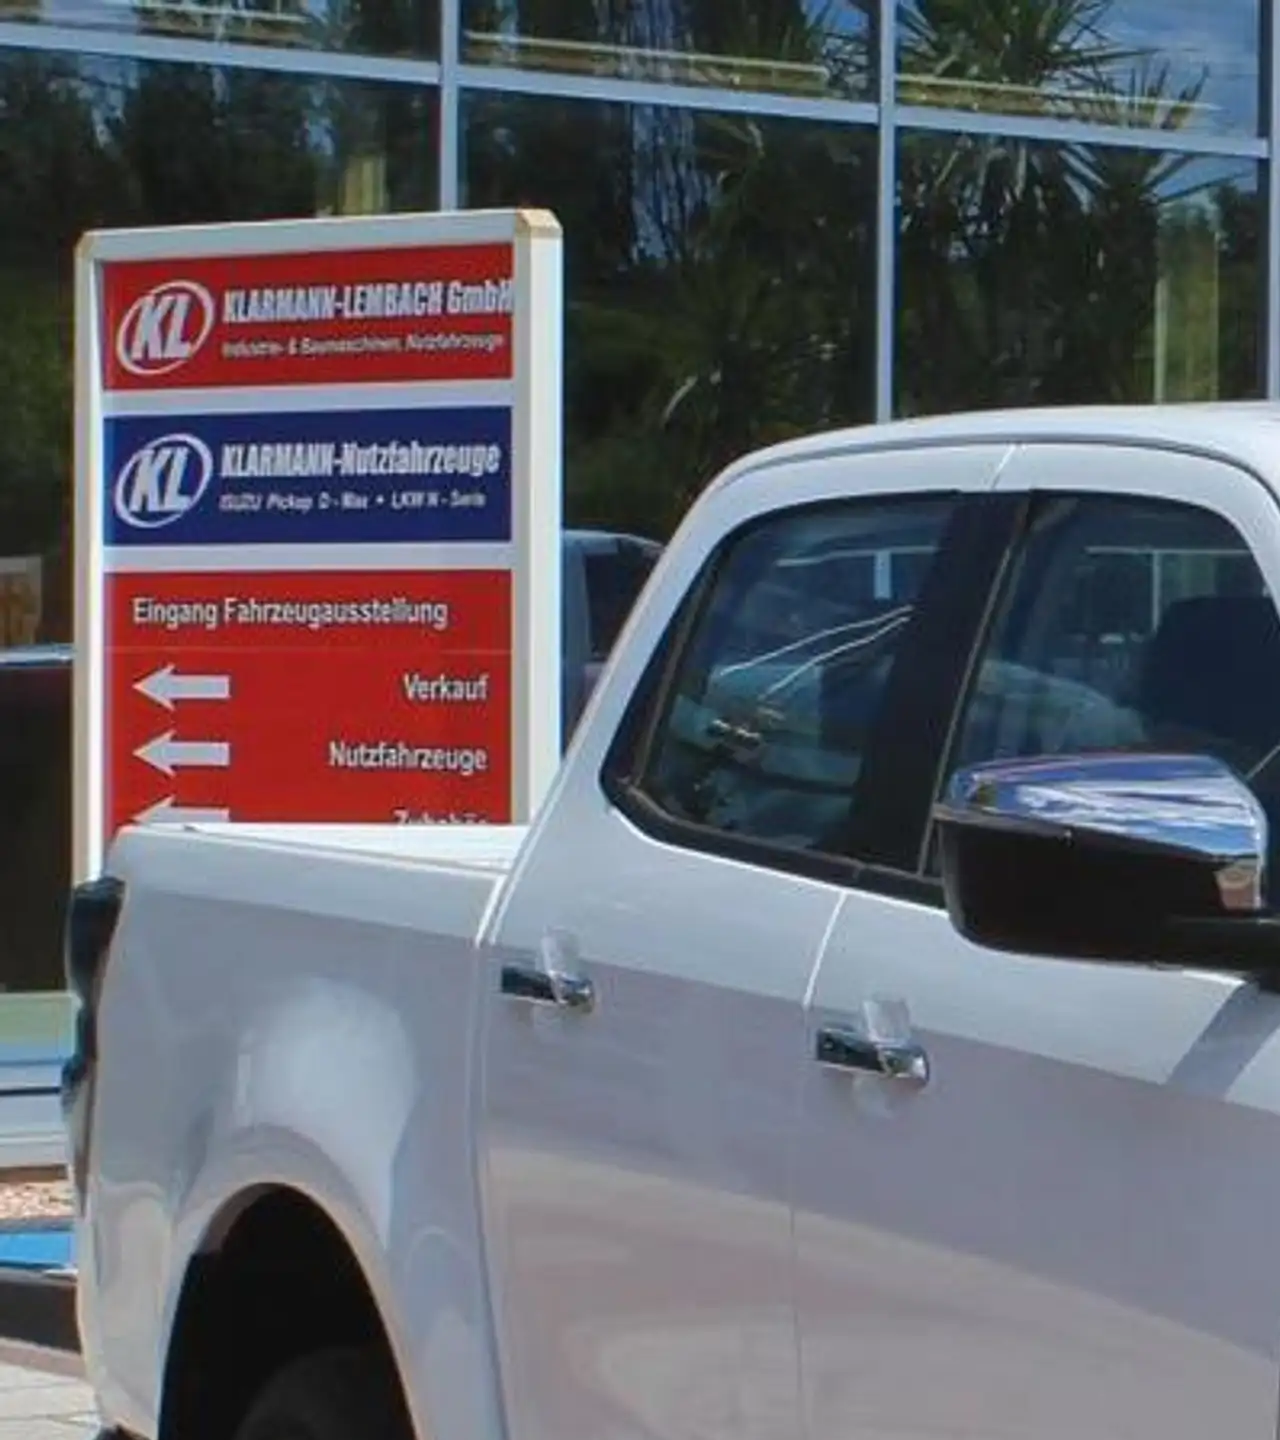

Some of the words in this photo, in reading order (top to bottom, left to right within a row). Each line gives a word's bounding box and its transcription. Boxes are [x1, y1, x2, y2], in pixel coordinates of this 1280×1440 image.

[222, 282, 443, 324] KLARMANN-LEMBACH
[447, 279, 513, 314] GmbH
[131, 292, 193, 361] KL
[219, 440, 501, 478] KLARMANN-Nutzfahrzeuge
[130, 446, 191, 514] KL
[218, 492, 262, 511] ISUZU
[266, 491, 314, 514] Pickup
[132, 597, 218, 630] Eingang
[222, 596, 448, 630] Fahrzeugausstellung
[402, 673, 488, 700] Verkauf
[329, 740, 488, 776] Nutzfahrzeuge
